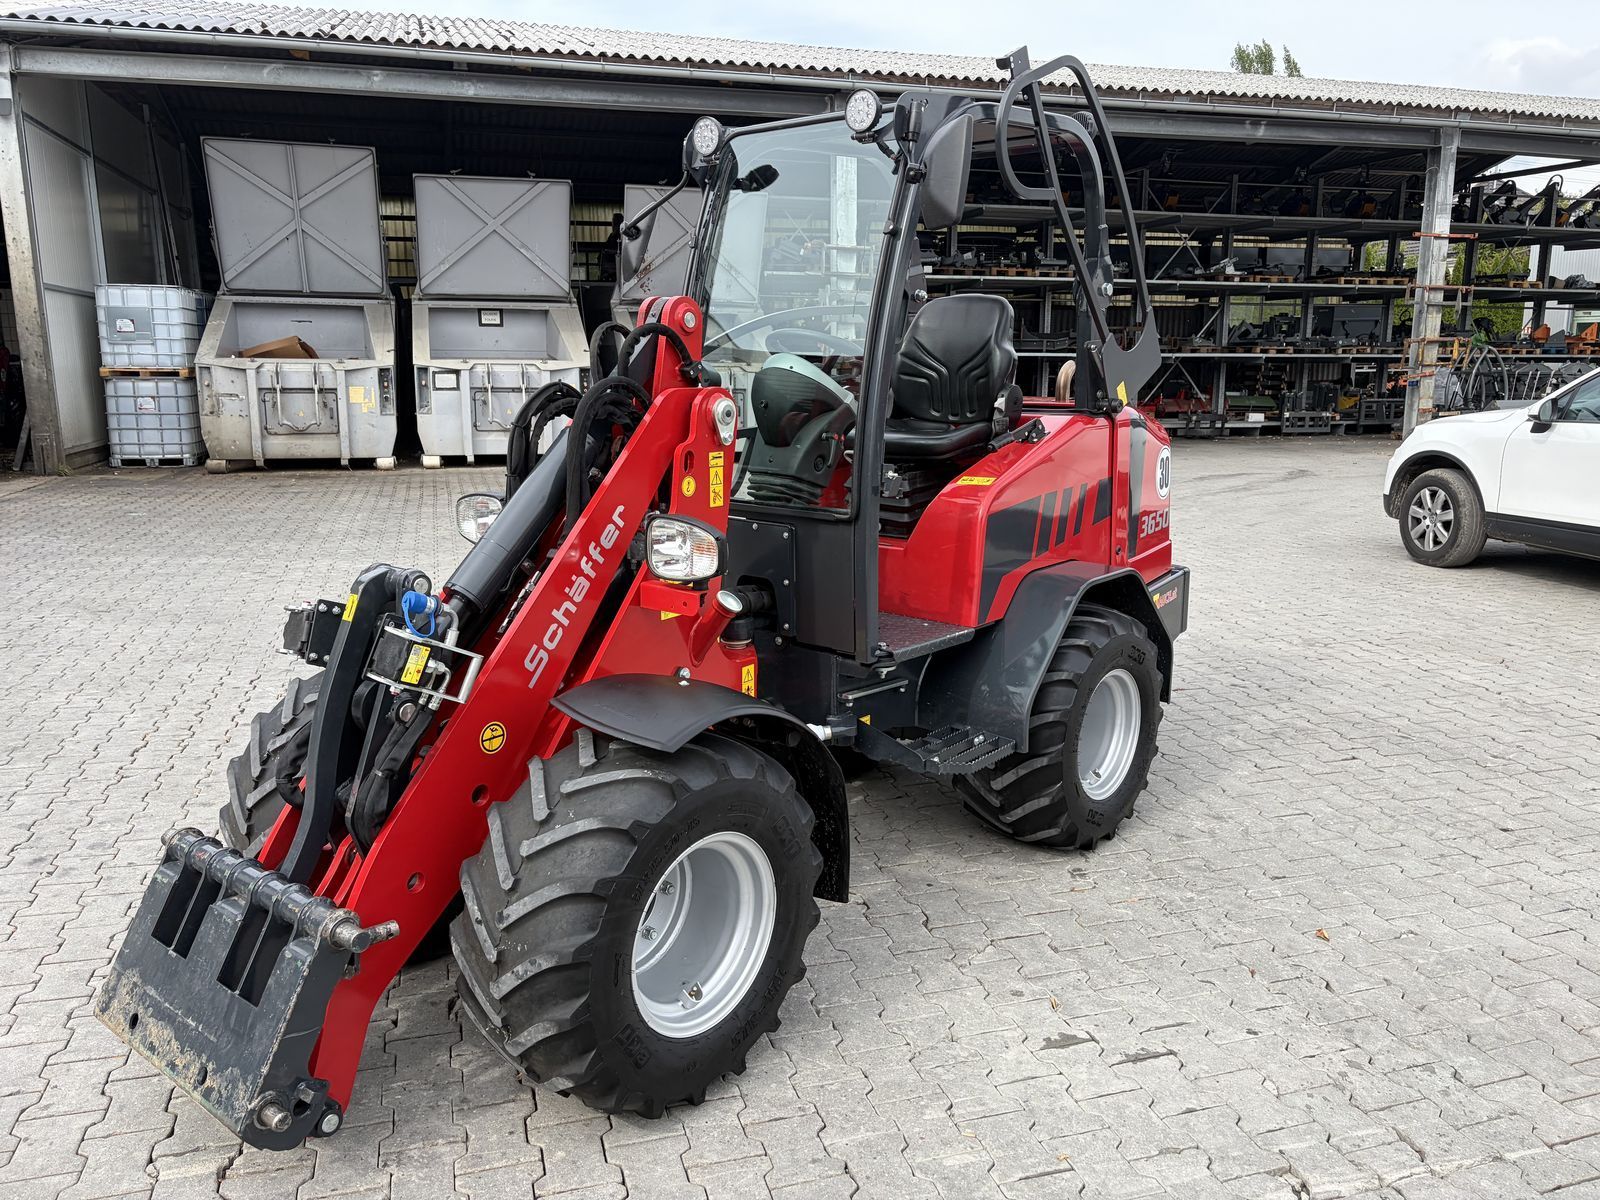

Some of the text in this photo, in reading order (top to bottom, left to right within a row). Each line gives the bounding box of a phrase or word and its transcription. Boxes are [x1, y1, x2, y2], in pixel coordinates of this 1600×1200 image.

[1159, 456, 1170, 490] 30
[1140, 508, 1170, 539] 3650
[524, 504, 625, 689] Schäffer
